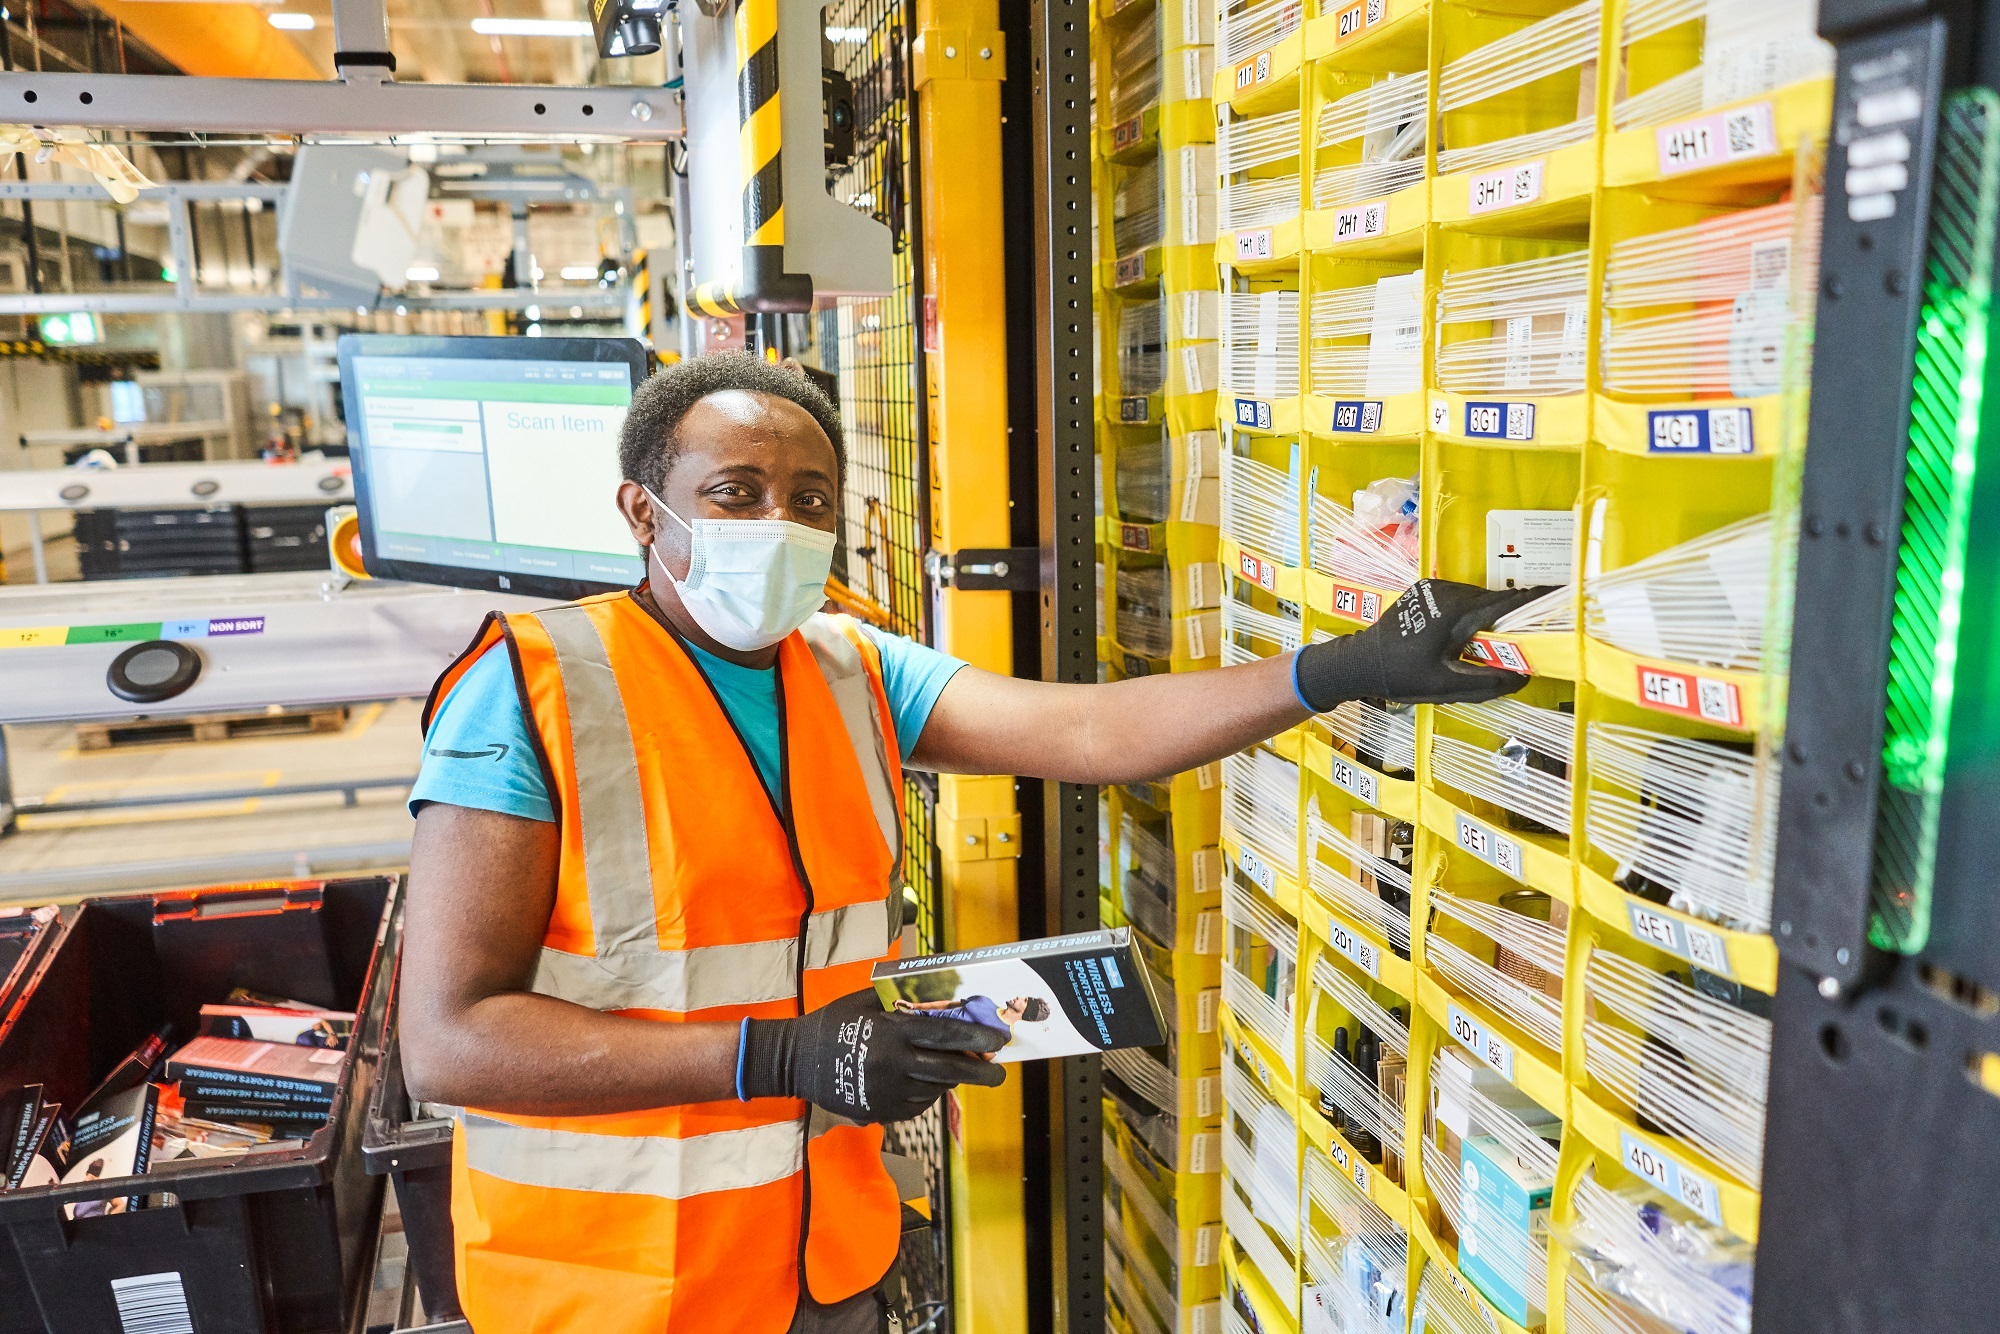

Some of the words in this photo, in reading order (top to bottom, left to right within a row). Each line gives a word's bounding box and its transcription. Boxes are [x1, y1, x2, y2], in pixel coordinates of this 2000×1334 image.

[507, 412, 555, 431] Scan
[562, 414, 604, 433] Item
[209, 621, 234, 633] NON
[235, 619, 264, 632] SORT
[1032, 934, 1102, 950] WIRELESS
[975, 944, 1030, 959] SPORTS
[898, 952, 973, 970] HEADWEAR
[1068, 970, 1076, 983] Your
[1072, 982, 1081, 997] Music
[1077, 996, 1085, 1006] and
[1085, 958, 1115, 1015] WIRELESS
[1073, 959, 1093, 997] SPORTS
[1087, 997, 1113, 1045] HEADWEAR
[185, 1068, 238, 1083] HEADWEAR
[238, 1075, 275, 1088] SPORTS
[197, 1086, 252, 1099] HEADWEAR
[275, 1080, 322, 1094] WIRELESS
[253, 1090, 291, 1101] SPORTS
[204, 1106, 260, 1116] HEADWEAR
[261, 1109, 298, 1119] SPORTS
[16, 1102, 33, 1147] WIRELESS
[140, 1103, 155, 1156] HEADWEAR
[26, 1116, 49, 1151] WIRELESS
[12, 1151, 33, 1180] SPORTS
